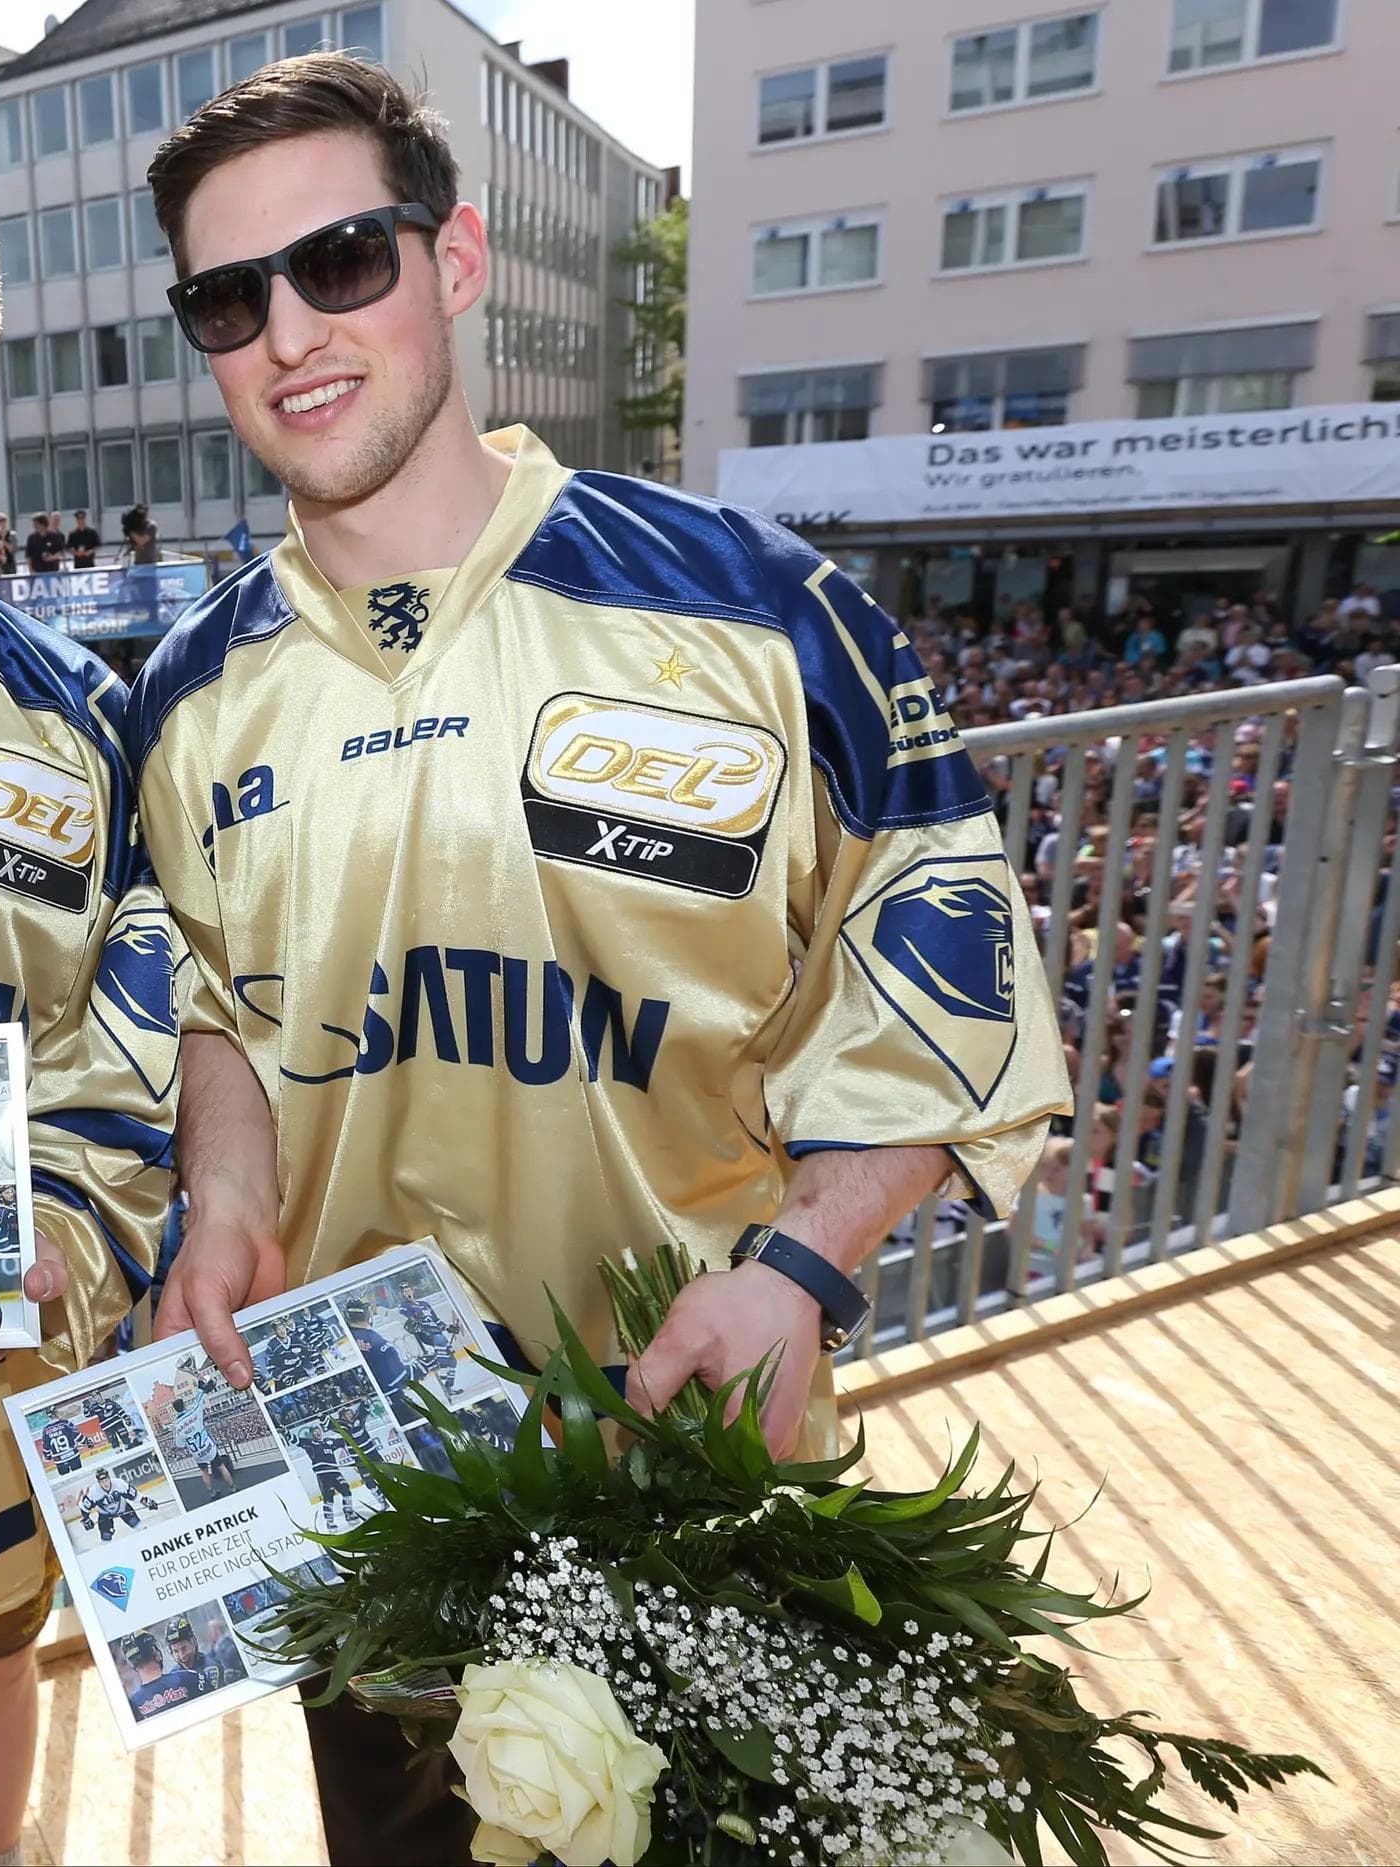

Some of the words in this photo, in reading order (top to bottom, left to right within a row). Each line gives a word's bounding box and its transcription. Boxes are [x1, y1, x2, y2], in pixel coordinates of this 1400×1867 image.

[926, 443, 1002, 467] Das
[1015, 438, 1099, 462] war
[925, 472, 972, 488] Wir
[11, 573, 110, 602] DANKE
[60, 601, 99, 616] EINE
[547, 734, 730, 811] DEL
[355, 944, 672, 1093] SATUN
[50, 1435, 70, 1453] 19
[140, 1531, 194, 1562] DANKE
[194, 1506, 259, 1541] PATRICK
[147, 1559, 178, 1582] FÜR
[178, 1545, 223, 1570] DEINE
[223, 1528, 254, 1552] ZEIT
[155, 1576, 193, 1601] BEIM
[193, 1563, 223, 1586] ERC
[223, 1532, 306, 1574] INGOLSTAD
